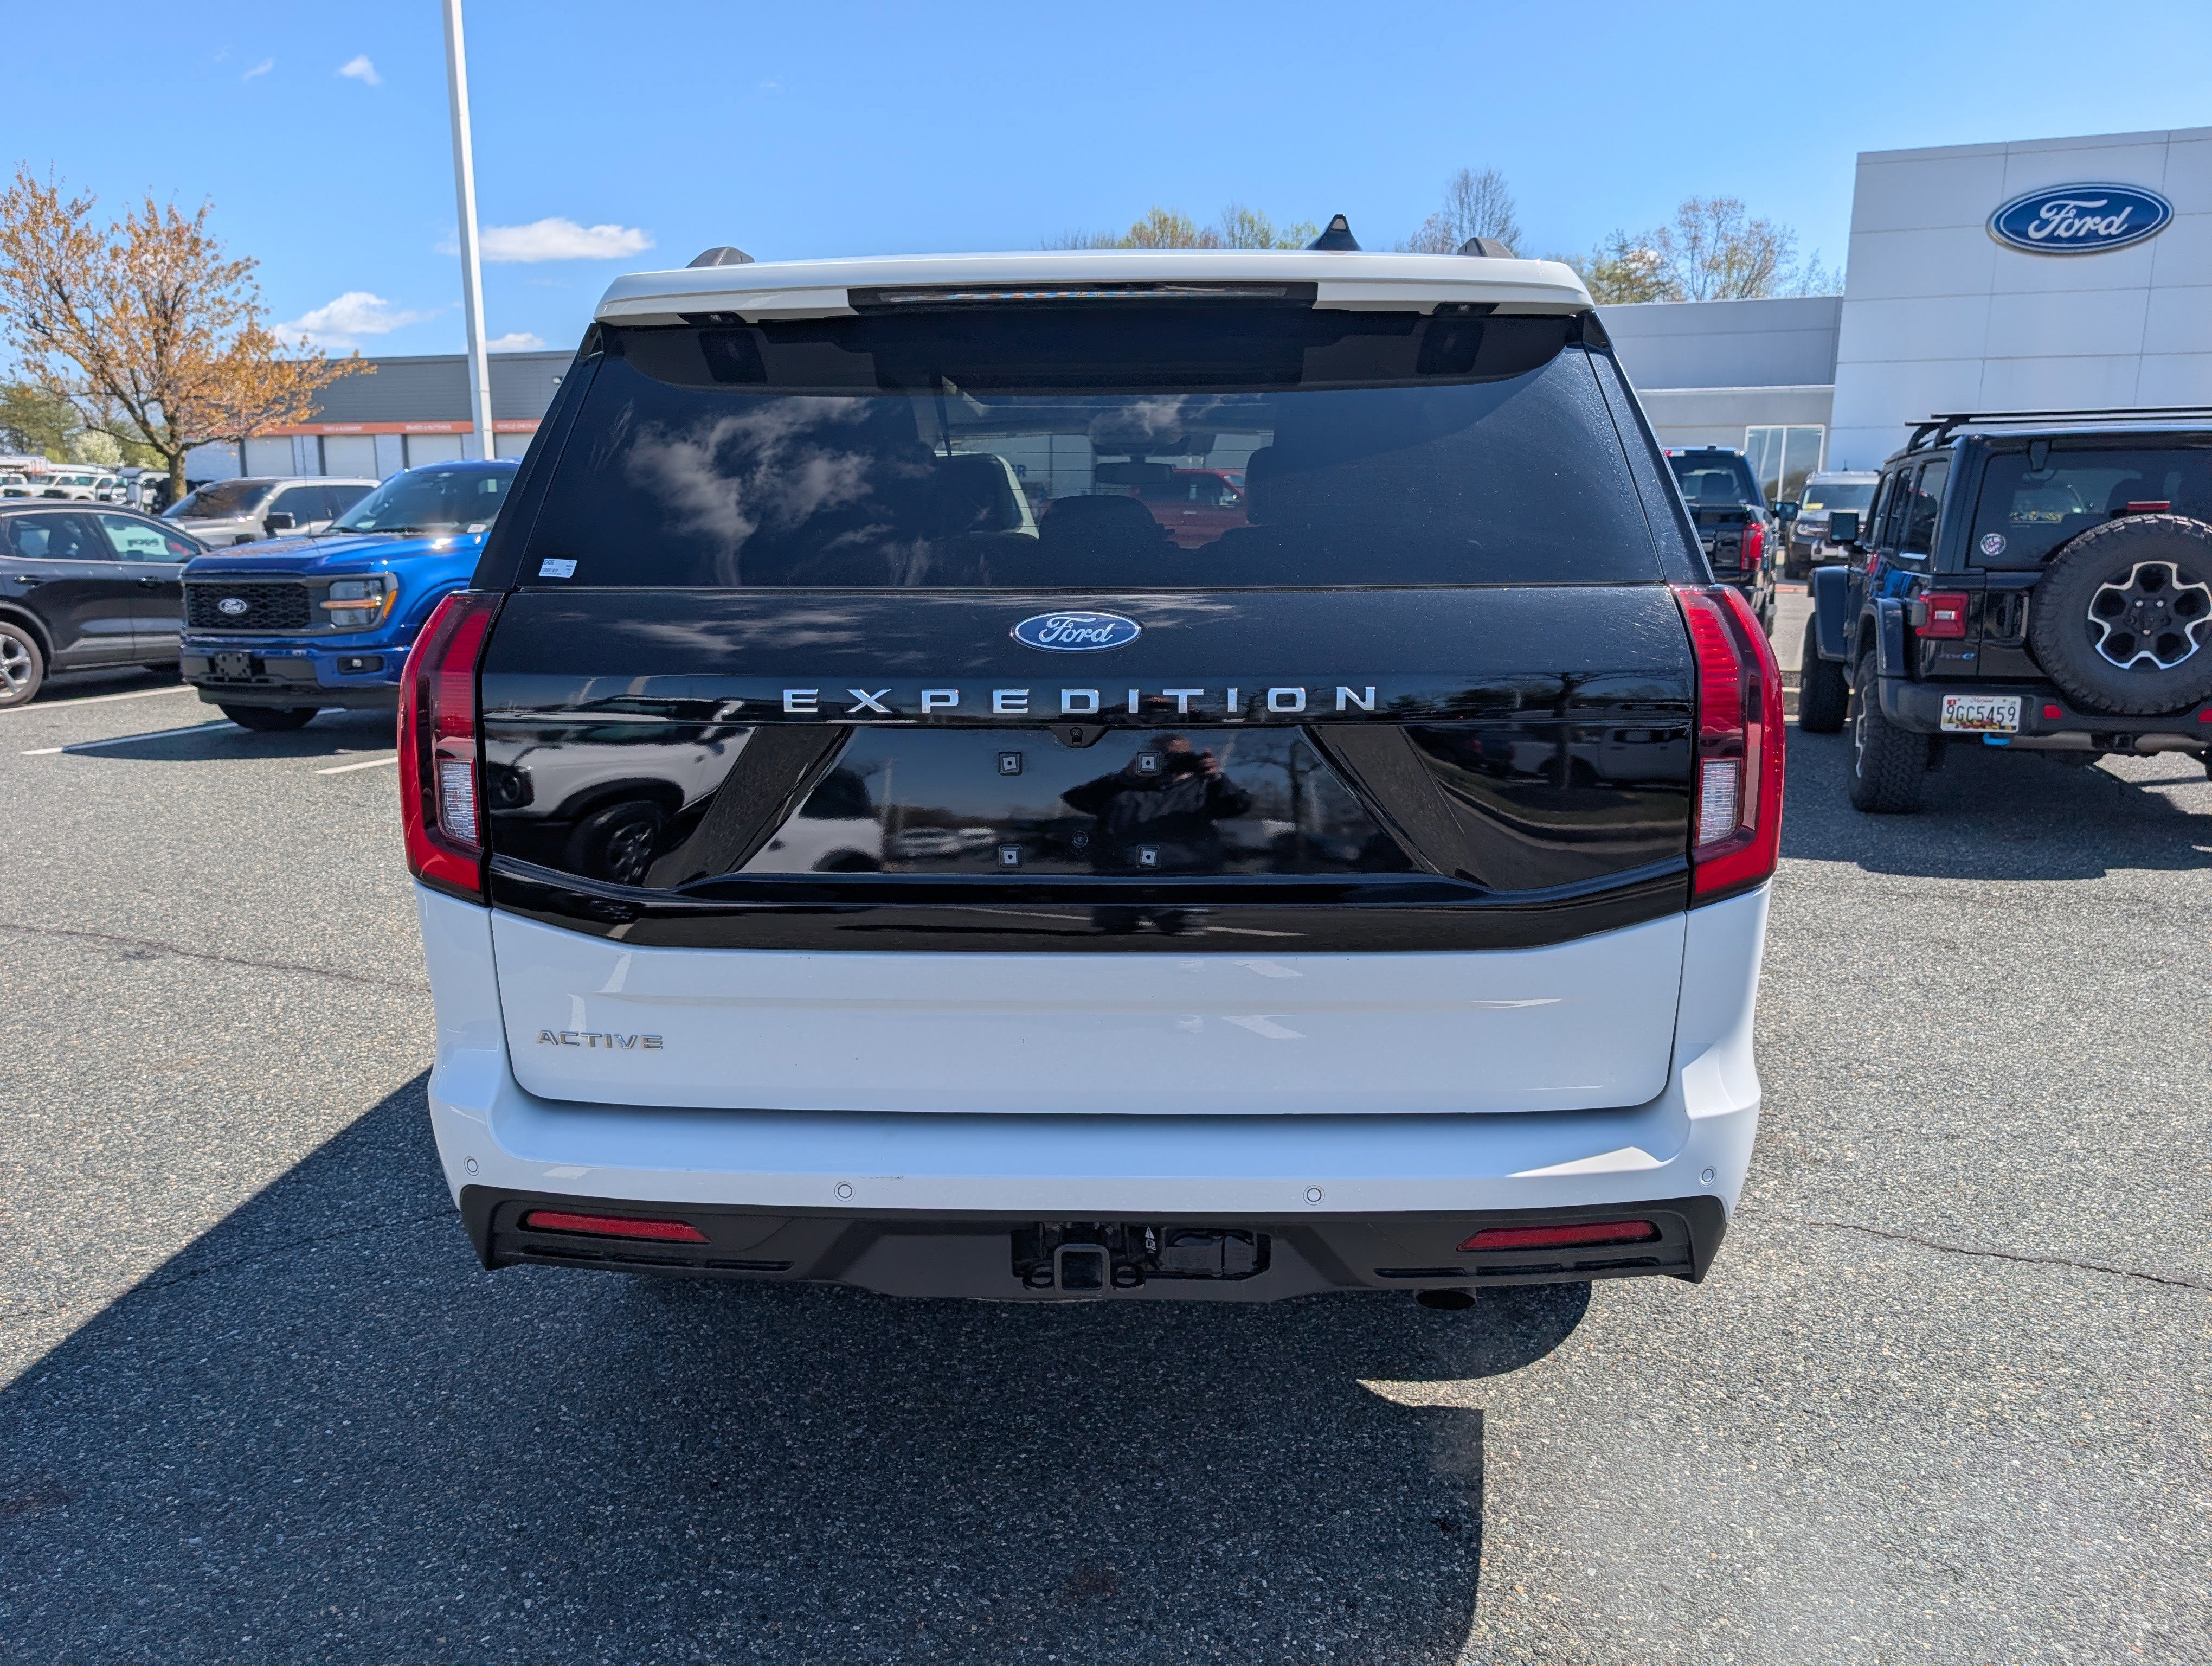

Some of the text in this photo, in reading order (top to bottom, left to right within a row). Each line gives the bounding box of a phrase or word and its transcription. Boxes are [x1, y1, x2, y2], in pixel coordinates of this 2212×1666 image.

[2027, 198, 2134, 240] Ford
[1038, 616, 1116, 643] Ford
[782, 686, 1376, 714] EXPEDITION
[1946, 704, 2016, 723] 9GC5459
[536, 1030, 663, 1050] ACTIVE
